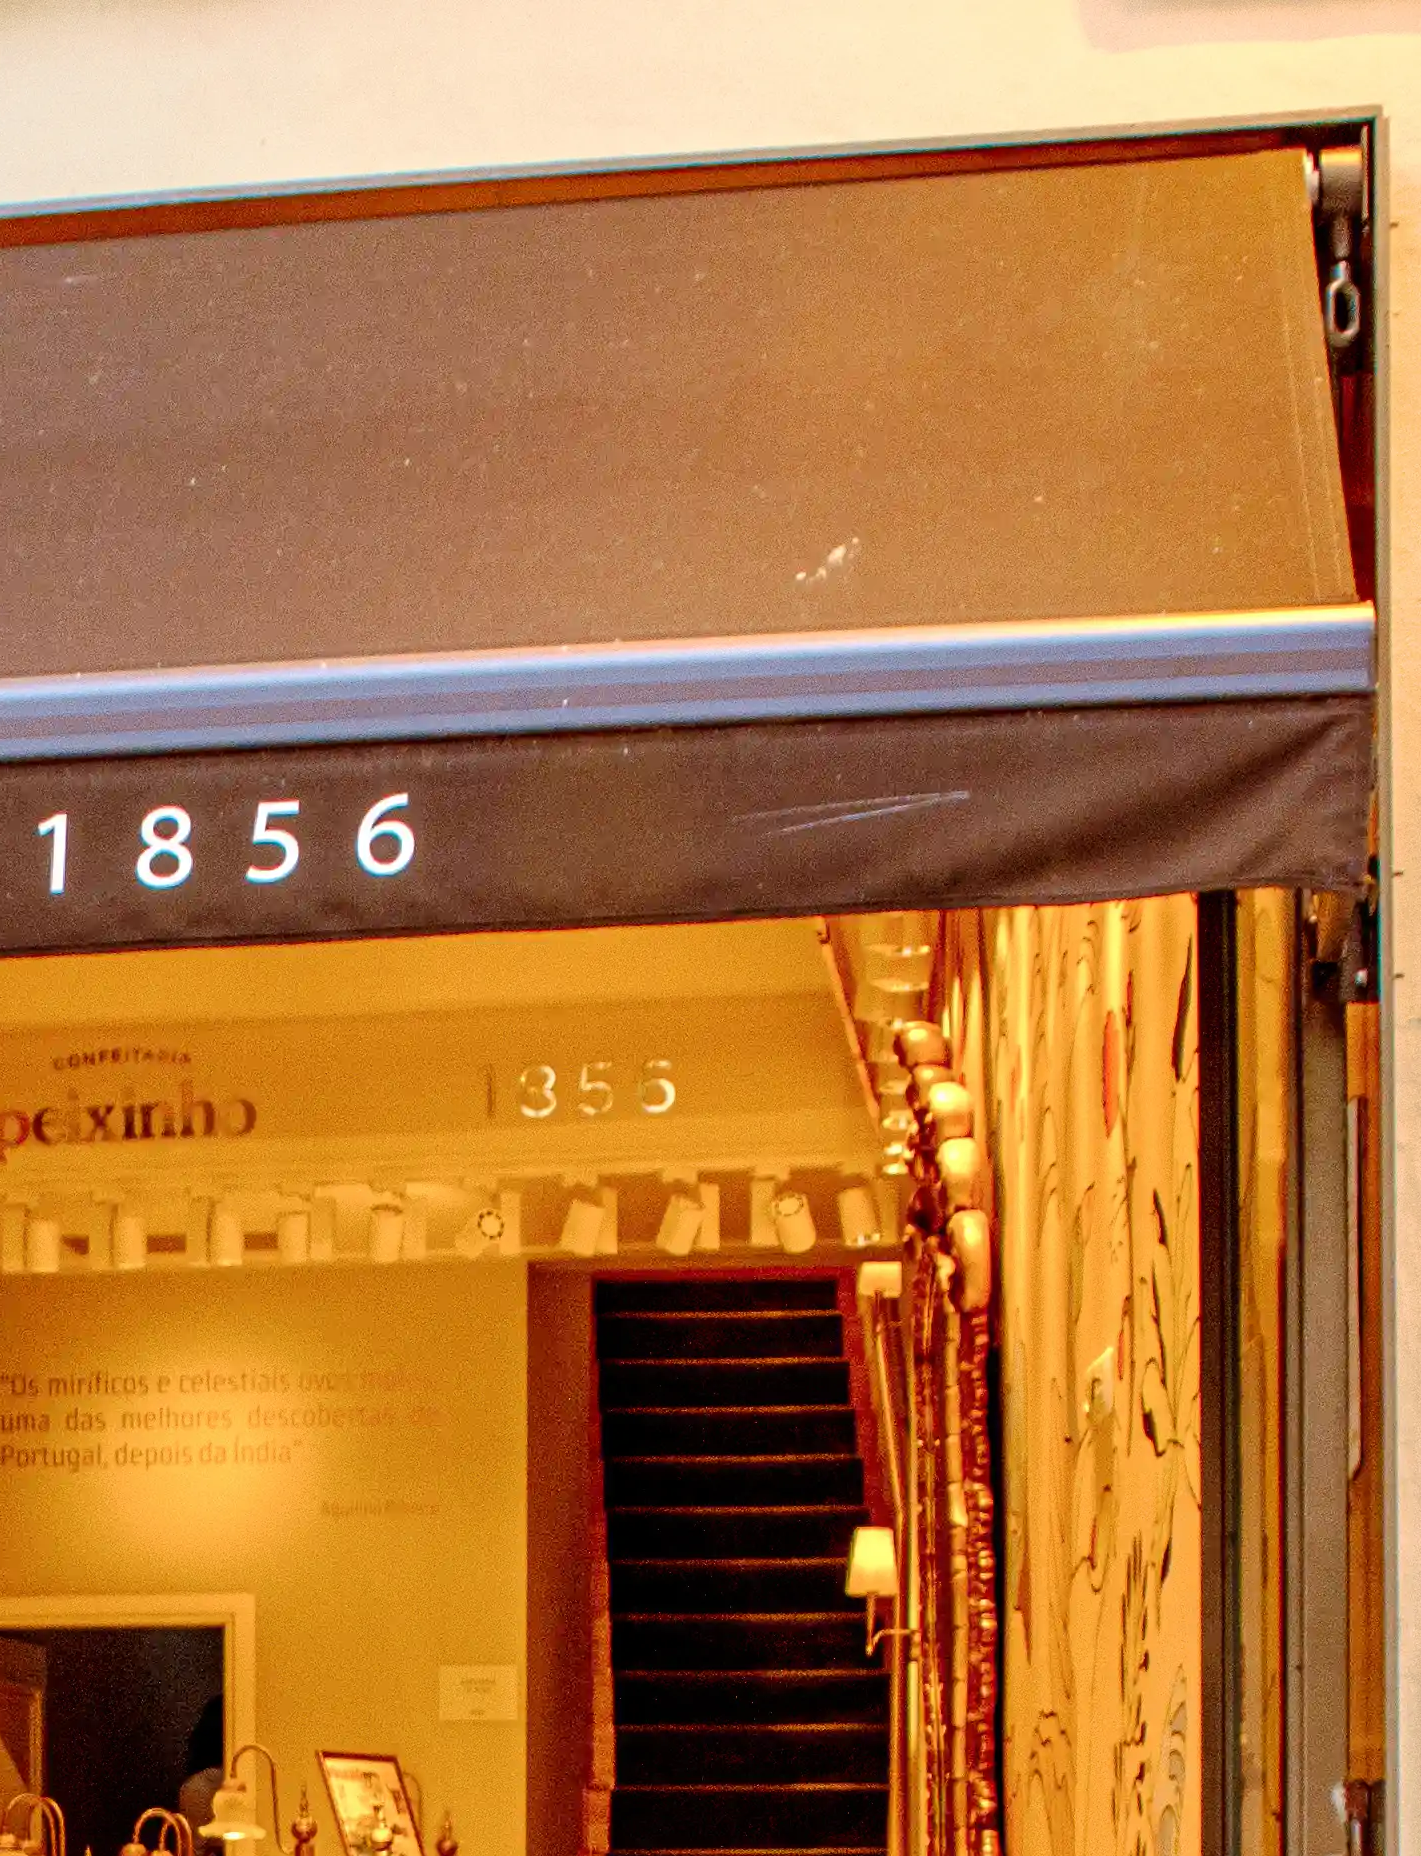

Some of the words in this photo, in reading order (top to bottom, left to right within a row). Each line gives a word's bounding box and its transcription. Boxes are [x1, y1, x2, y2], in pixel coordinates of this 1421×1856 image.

[156, 1374, 171, 1395] e
[178, 1368, 290, 1395] celestiais
[0, 1411, 51, 1434] uma
[64, 1407, 107, 1433] das
[121, 1406, 233, 1431] melhores
[113, 1440, 194, 1471] depois
[197, 1440, 227, 1465] da
